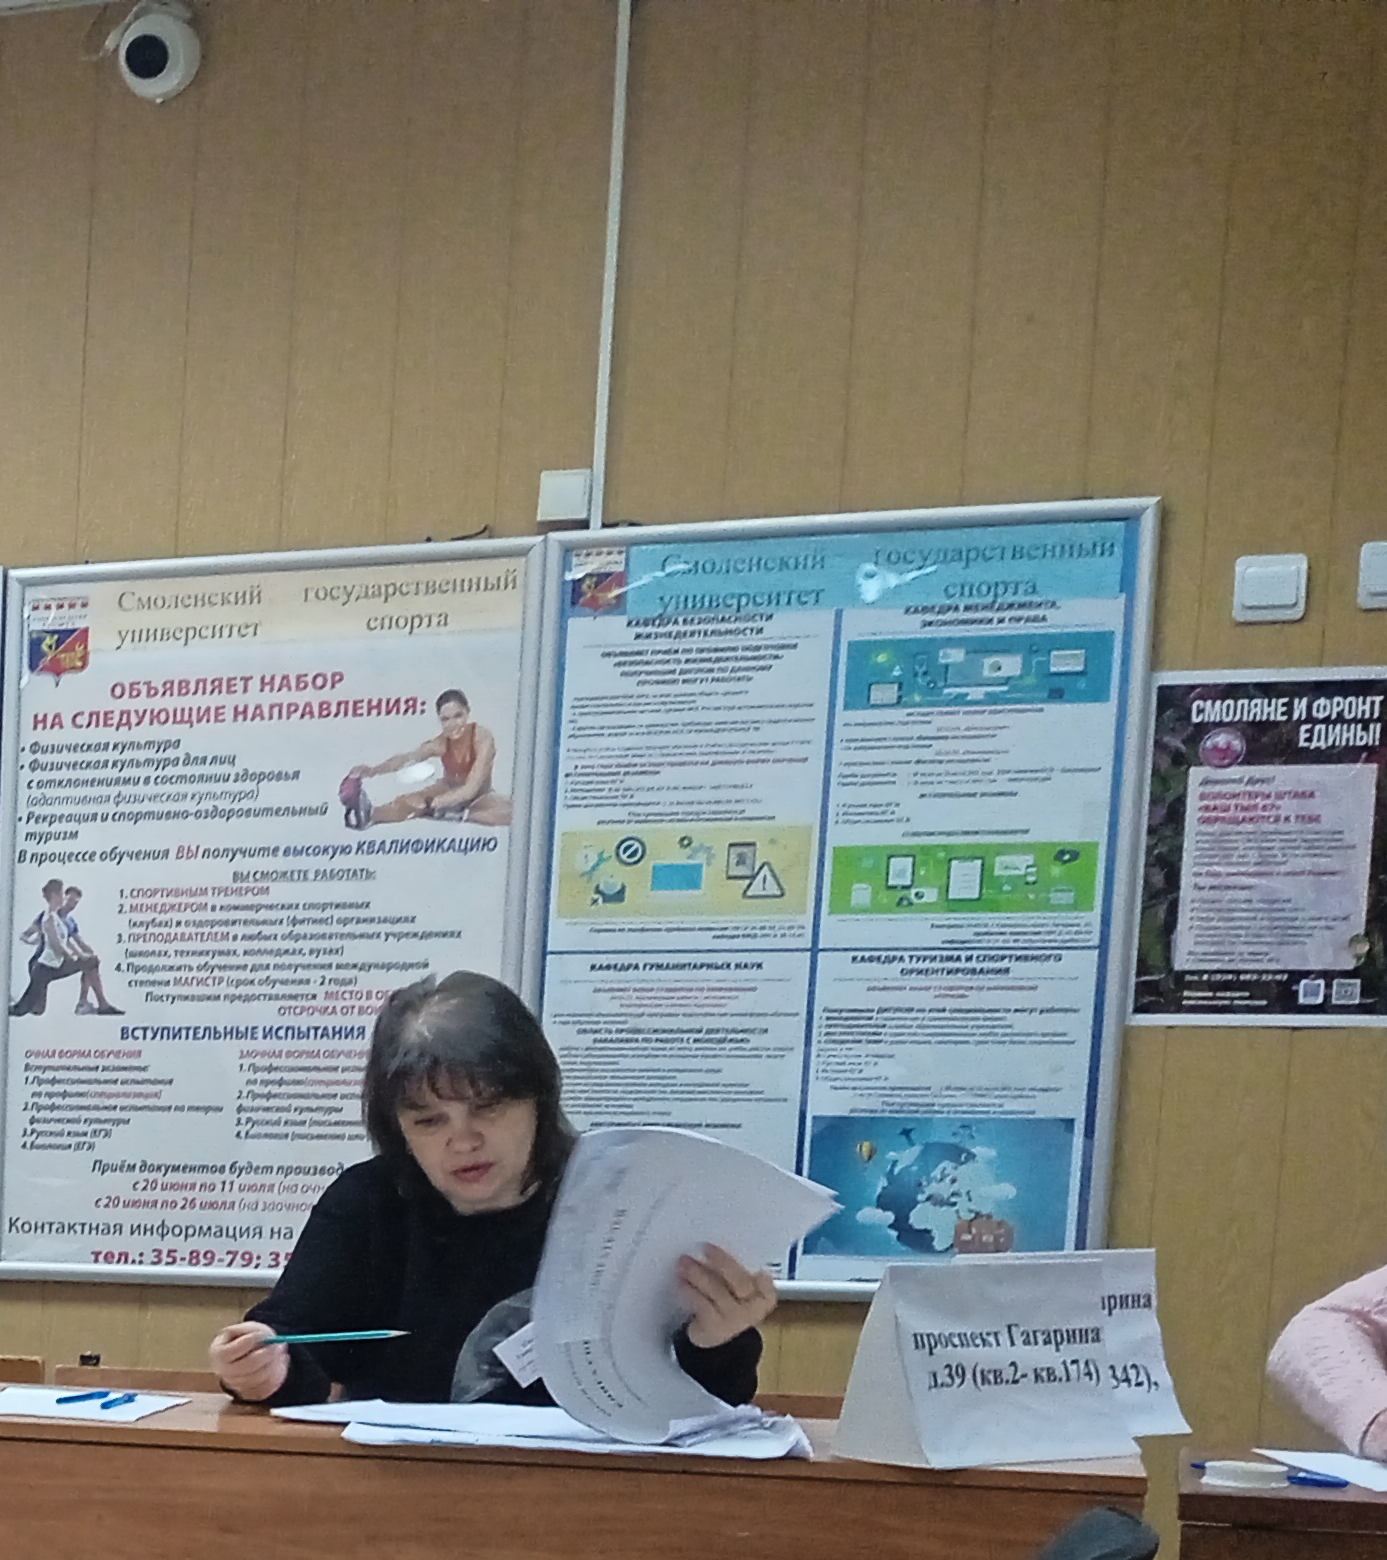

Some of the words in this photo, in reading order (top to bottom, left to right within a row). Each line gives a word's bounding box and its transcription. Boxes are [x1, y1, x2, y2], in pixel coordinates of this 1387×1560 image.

[661, 549, 826, 577] Смоленский
[117, 584, 263, 613] Смоленский
[303, 568, 518, 606] государственный
[658, 588, 826, 618] университет
[943, 579, 1038, 602] спорта
[115, 620, 263, 650] университет
[366, 611, 450, 635] спорта
[110, 675, 254, 700] ОБЪЯВЛЯЕТ
[258, 671, 345, 694] НАБОР
[32, 711, 65, 731] НА
[71, 704, 227, 732] СЛЕДУЮЩИЕ
[232, 696, 428, 723] НАПРАВЛЕНИЯ:
[1191, 697, 1289, 724] СМОЛЯНЕ
[1292, 698, 1308, 721] И
[1312, 695, 1384, 719] ФРОНТ
[29, 740, 110, 756] Физическая
[111, 738, 181, 757] культура
[1298, 723, 1381, 749] ЕДИНЫ!
[28, 757, 109, 773] Физическая
[110, 755, 180, 774] культура
[182, 753, 207, 768] для
[209, 754, 237, 768] лиц
[36, 774, 141, 789] отклонениями
[153, 771, 230, 786] состоянии
[232, 768, 301, 785] здоровья
[26, 791, 111, 808] (адаптивная
[113, 788, 188, 806] физическая
[190, 784, 260, 805] культура)
[25, 811, 98, 828] Рекреация
[111, 802, 329, 824] спортивно-оздоровительный
[24, 829, 79, 845] туризм
[17, 849, 27, 864] В
[29, 850, 97, 867] процессе
[99, 845, 170, 865] обучения
[176, 845, 200, 860] ВЫ
[202, 844, 279, 863] получите
[282, 842, 353, 861] высокую
[355, 836, 499, 857] КВАЛИФИКАЦИЮ
[130, 886, 208, 898] СПОРТИВНЫМ
[211, 885, 270, 897] ТРЕНЕРОМ
[120, 1026, 259, 1042] ВСТУПИТЕЛЬНЫЕ
[262, 1025, 367, 1041] ИСПЫТАНИЯ
[91, 1158, 137, 1176] Приём
[139, 1160, 226, 1177] документов
[229, 1160, 273, 1179] будет
[276, 1163, 347, 1178] производ
[7, 1217, 124, 1236] Контактная
[129, 1219, 263, 1242] информация
[270, 1227, 294, 1241] на
[90, 1251, 144, 1265] тел.:
[150, 1249, 262, 1269] 35-89-79;
[1101, 1290, 1152, 1317] рина
[913, 1330, 1002, 1355] проспект
[1006, 1323, 1102, 1352] Гагарина
[928, 1365, 966, 1391] д.39
[972, 1361, 1028, 1391] (кв.2-
[1032, 1358, 1101, 1387] кв.174)
